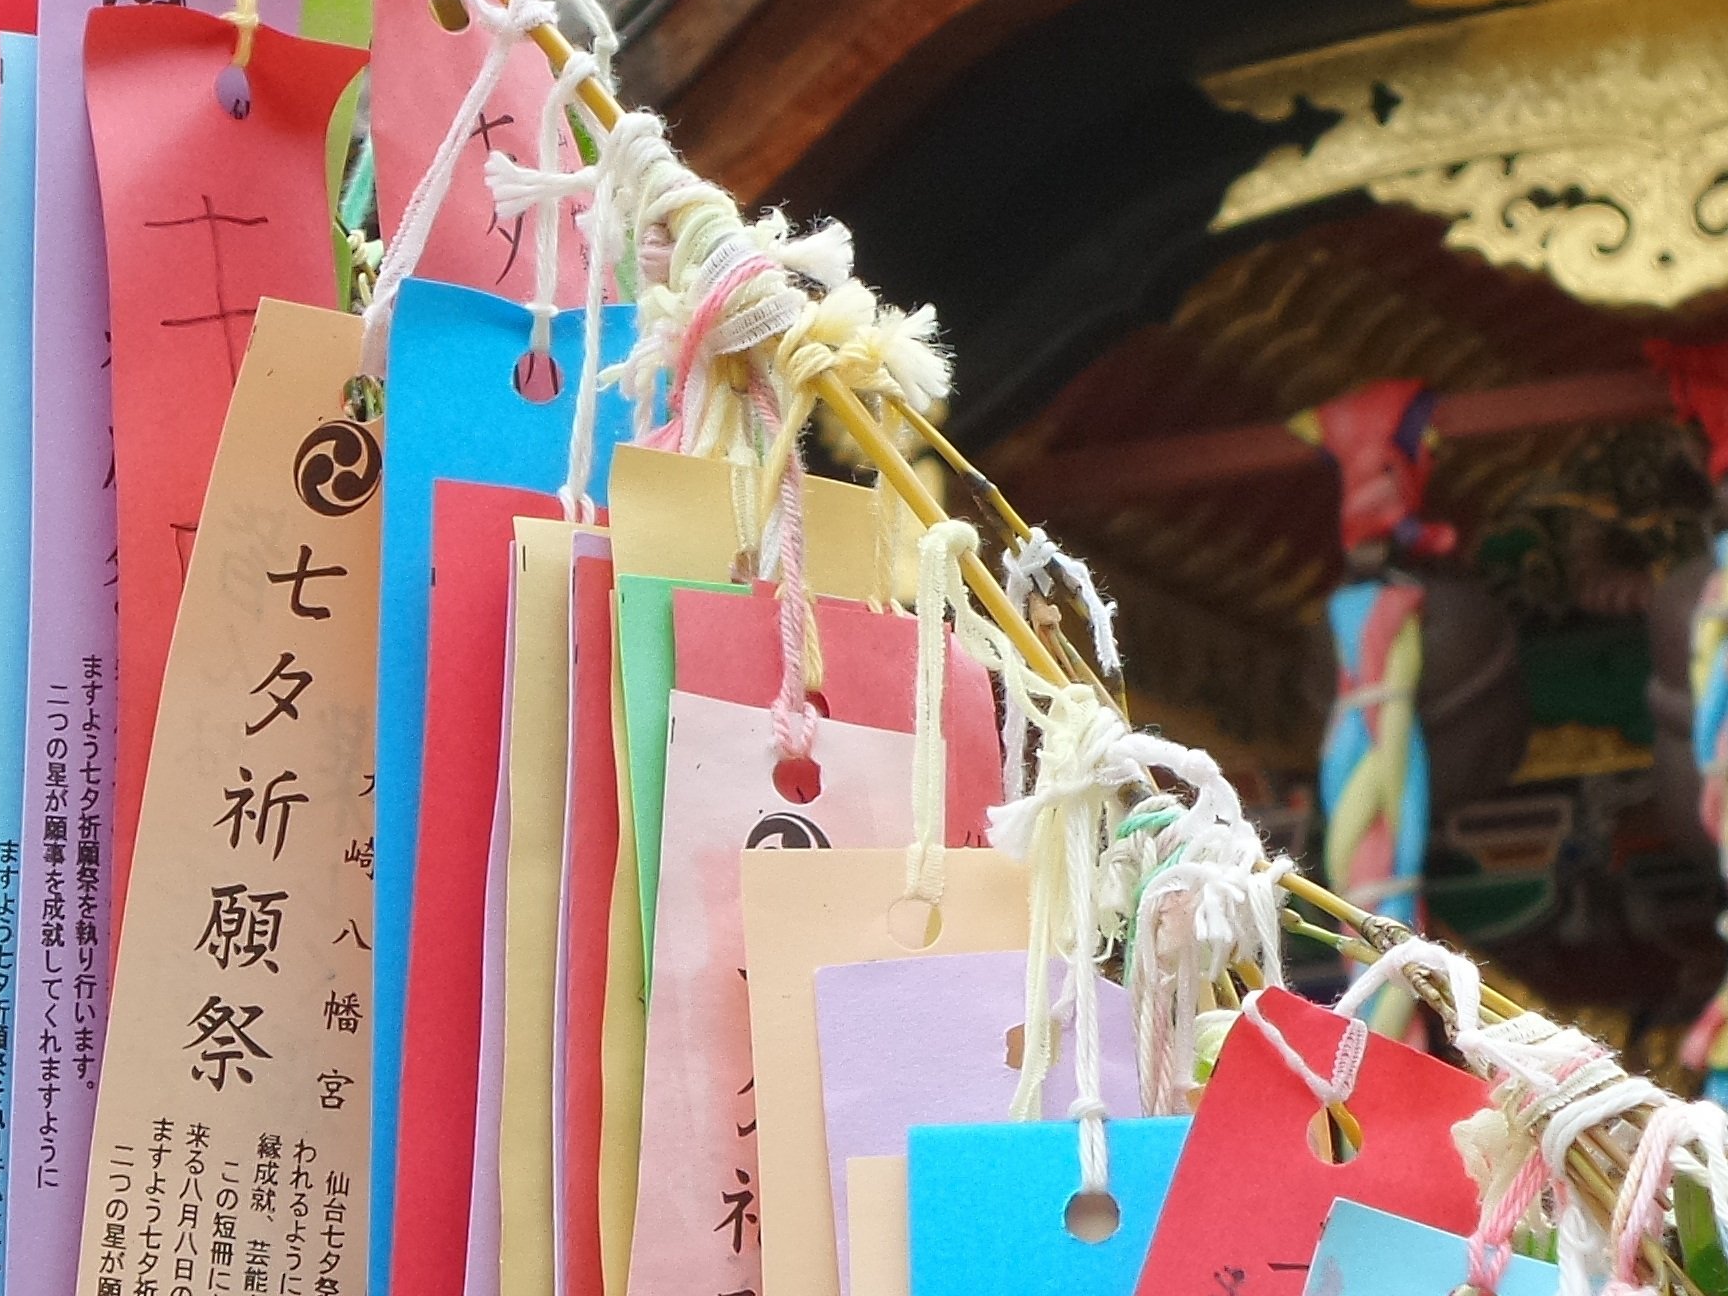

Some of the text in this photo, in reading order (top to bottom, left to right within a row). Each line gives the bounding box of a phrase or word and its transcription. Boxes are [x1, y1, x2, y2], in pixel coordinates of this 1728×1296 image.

[181, 544, 348, 1093] 七夕祈願祭
